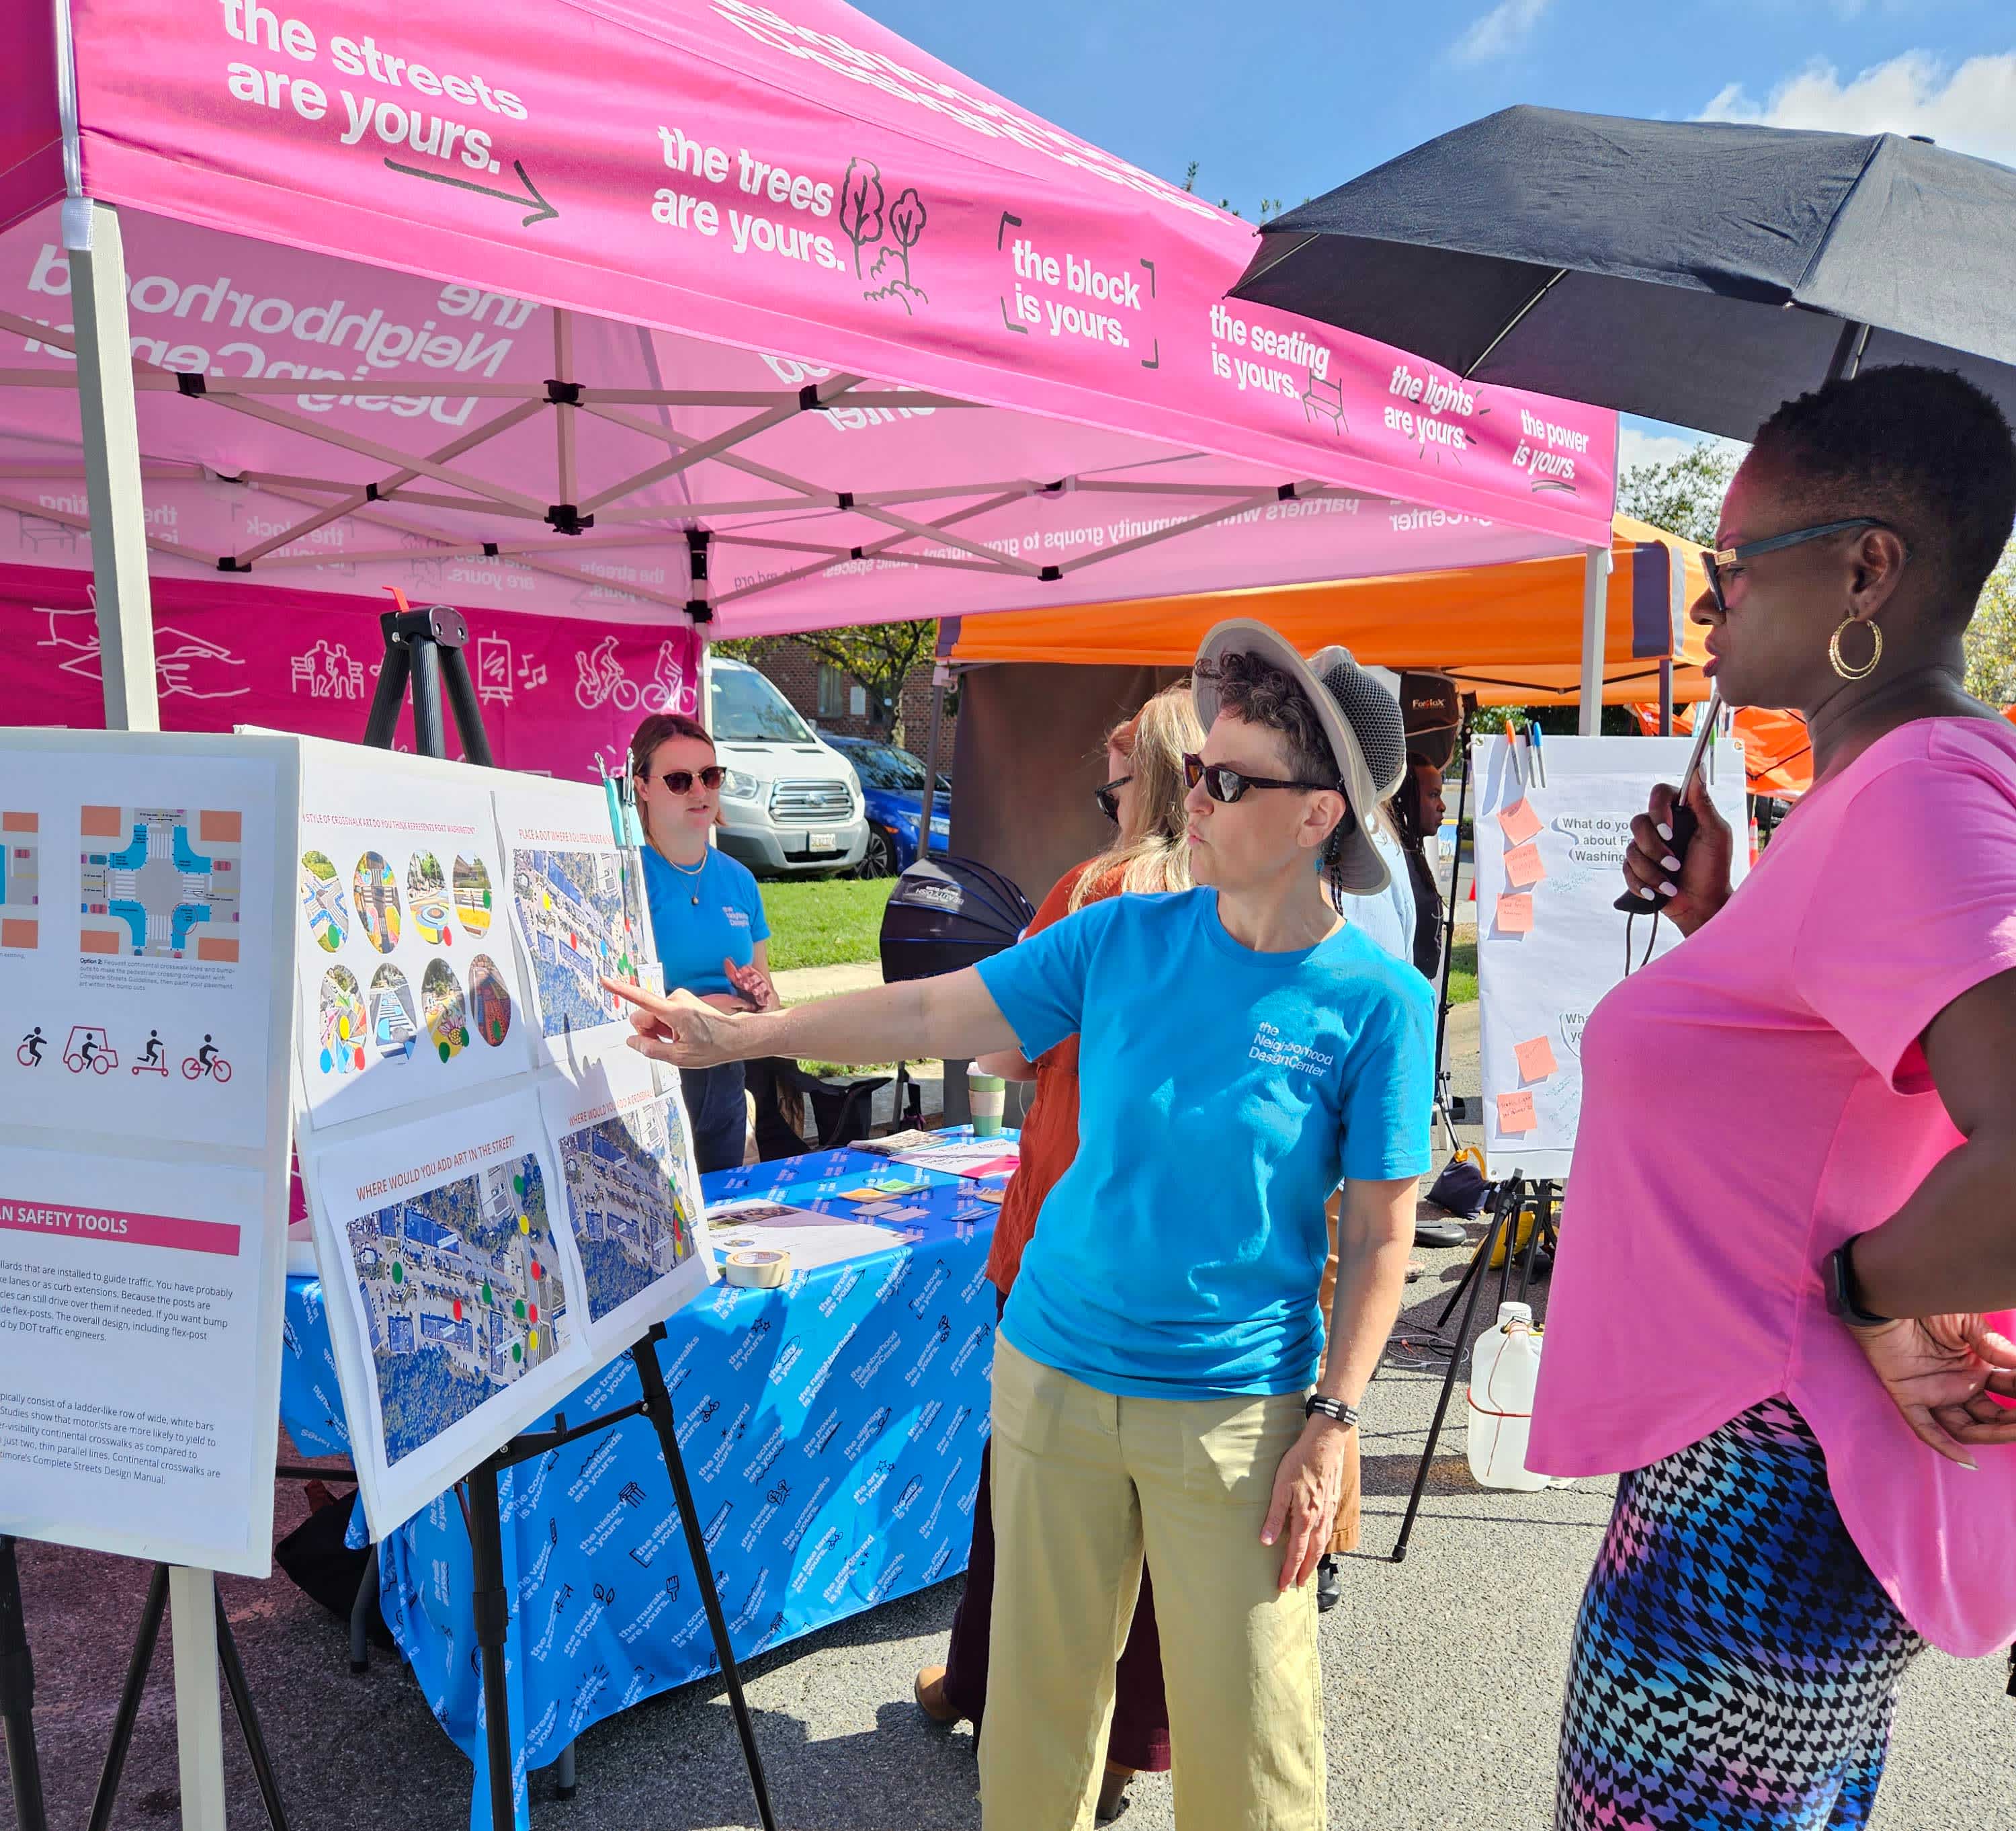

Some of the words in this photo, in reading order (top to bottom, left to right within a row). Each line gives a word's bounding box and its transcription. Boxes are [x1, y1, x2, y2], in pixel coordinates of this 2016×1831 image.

[220, 0, 317, 63] the
[330, 36, 528, 121] streets
[226, 61, 327, 120] are
[340, 89, 501, 175] yours.
[658, 126, 728, 183] the
[738, 149, 834, 216] trees
[651, 188, 719, 235] are
[728, 209, 846, 272] yours.
[1012, 239, 1060, 286] the
[1066, 253, 1141, 311] block
[1015, 284, 1042, 323] is
[1046, 300, 1130, 348] yours.
[1210, 304, 1247, 347] the
[1251, 325, 1331, 380] seating
[1211, 345, 1231, 380] is
[1233, 357, 1300, 400] yours.
[1388, 365, 1421, 399] the
[1423, 376, 1474, 416] lights
[1384, 405, 1413, 432] are
[1416, 418, 1467, 450] yours.
[1521, 409, 1545, 440] the
[1546, 423, 1589, 454] power
[1512, 440, 1529, 467] is
[1527, 451, 1575, 480] yours.
[1563, 818, 1592, 829] What
[1596, 818, 1611, 829] do
[1615, 821, 1629, 833] yo
[1583, 834, 1616, 846] about
[1575, 850, 1625, 864] Washing
[1253, 1032, 1334, 1065] Neighborhood
[1259, 1021, 1279, 1036] the
[1248, 1047, 1327, 1077] DesignCenter
[356, 1178, 387, 1202] WHERE
[388, 1168, 420, 1190] WOULD
[421, 1162, 436, 1178] YOU
[437, 1156, 452, 1173] ADD
[454, 1151, 468, 1167] ART
[468, 1147, 478, 1162] IN
[478, 1145, 492, 1158] THE
[492, 1135, 515, 1153] STREET?
[17, 1207, 73, 1227] SAFETY
[75, 1213, 128, 1234] TOOLS
[9, 1274, 30, 1287] lanes
[32, 1280, 41, 1288] or
[42, 1281, 52, 1290] as
[53, 1282, 72, 1292] curb
[74, 1285, 119, 1299] extensions.
[121, 1289, 155, 1303] Because
[157, 1295, 171, 1305] the
[173, 1298, 195, 1308] posts
[197, 1301, 210, 1310] are
[24, 1262, 40, 1274] that
[42, 1266, 56, 1275] are
[57, 1268, 91, 1280] installed
[93, 1272, 101, 1281] to
[103, 1272, 127, 1285] guide
[128, 1276, 154, 1288] traffic.
[156, 1278, 172, 1290] You
[174, 1281, 195, 1293] have
[196, 1286, 233, 1301] probably
[16, 1293, 31, 1302] can
[32, 1294, 47, 1304] still
[48, 1295, 69, 1307] drive
[71, 1299, 89, 1309] over
[90, 1300, 112, 1313] them
[114, 1303, 119, 1313] if
[121, 1306, 154, 1318] needed.
[156, 1309, 163, 1319] If
[163, 1311, 179, 1322] you
[180, 1314, 202, 1324] want
[203, 1315, 228, 1330] bump
[27, 1396, 54, 1408] consist
[56, 1399, 66, 1409] of
[75, 1401, 118, 1416] ladder-like
[119, 1409, 135, 1419] row
[136, 1410, 146, 1420] of
[147, 1413, 169, 1426] wide,
[171, 1416, 194, 1428] white
[196, 1418, 215, 1431] bars
[33, 1454, 72, 1469] Complete
[73, 1461, 102, 1474] Streets
[104, 1465, 132, 1479] Design
[134, 1469, 165, 1485] Manual.
